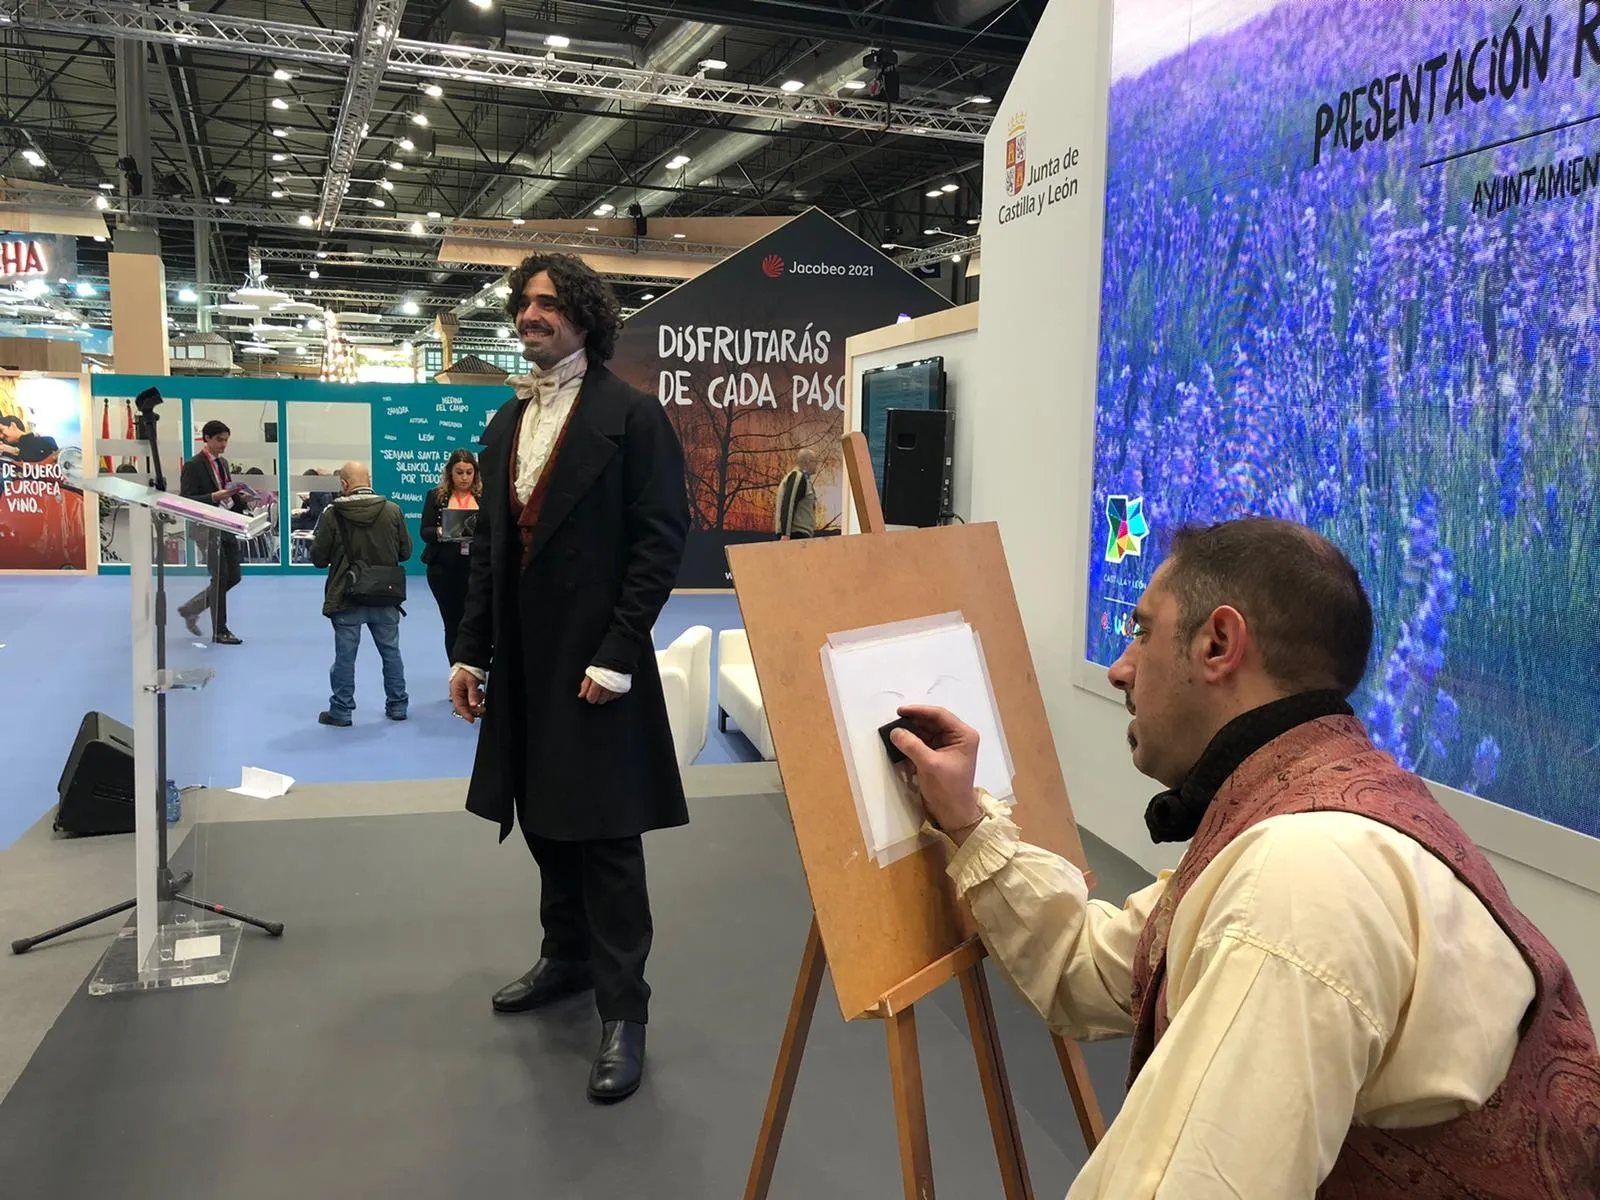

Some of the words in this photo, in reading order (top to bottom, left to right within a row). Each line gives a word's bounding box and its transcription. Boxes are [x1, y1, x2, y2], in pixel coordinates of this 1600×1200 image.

[1027, 157, 1060, 187] Junta
[1063, 146, 1079, 170] de
[998, 195, 1035, 225] Castilla
[1037, 192, 1045, 216] y
[1048, 177, 1078, 205] León
[0, 240, 46, 275] HA
[789, 261, 846, 276] Jacobeo
[848, 264, 874, 277] 2021
[658, 370, 693, 407] DE
[708, 372, 778, 409] CADA
[435, 403, 447, 412] DEL
[449, 404, 469, 412] CAMPO
[418, 433, 435, 442] LEÓN
[417, 451, 440, 461] SANTA
[2, 463, 17, 479] DE
[396, 461, 431, 473] SILENCIO,
[401, 473, 416, 484] POR
[4, 480, 61, 497] EUROPEA
